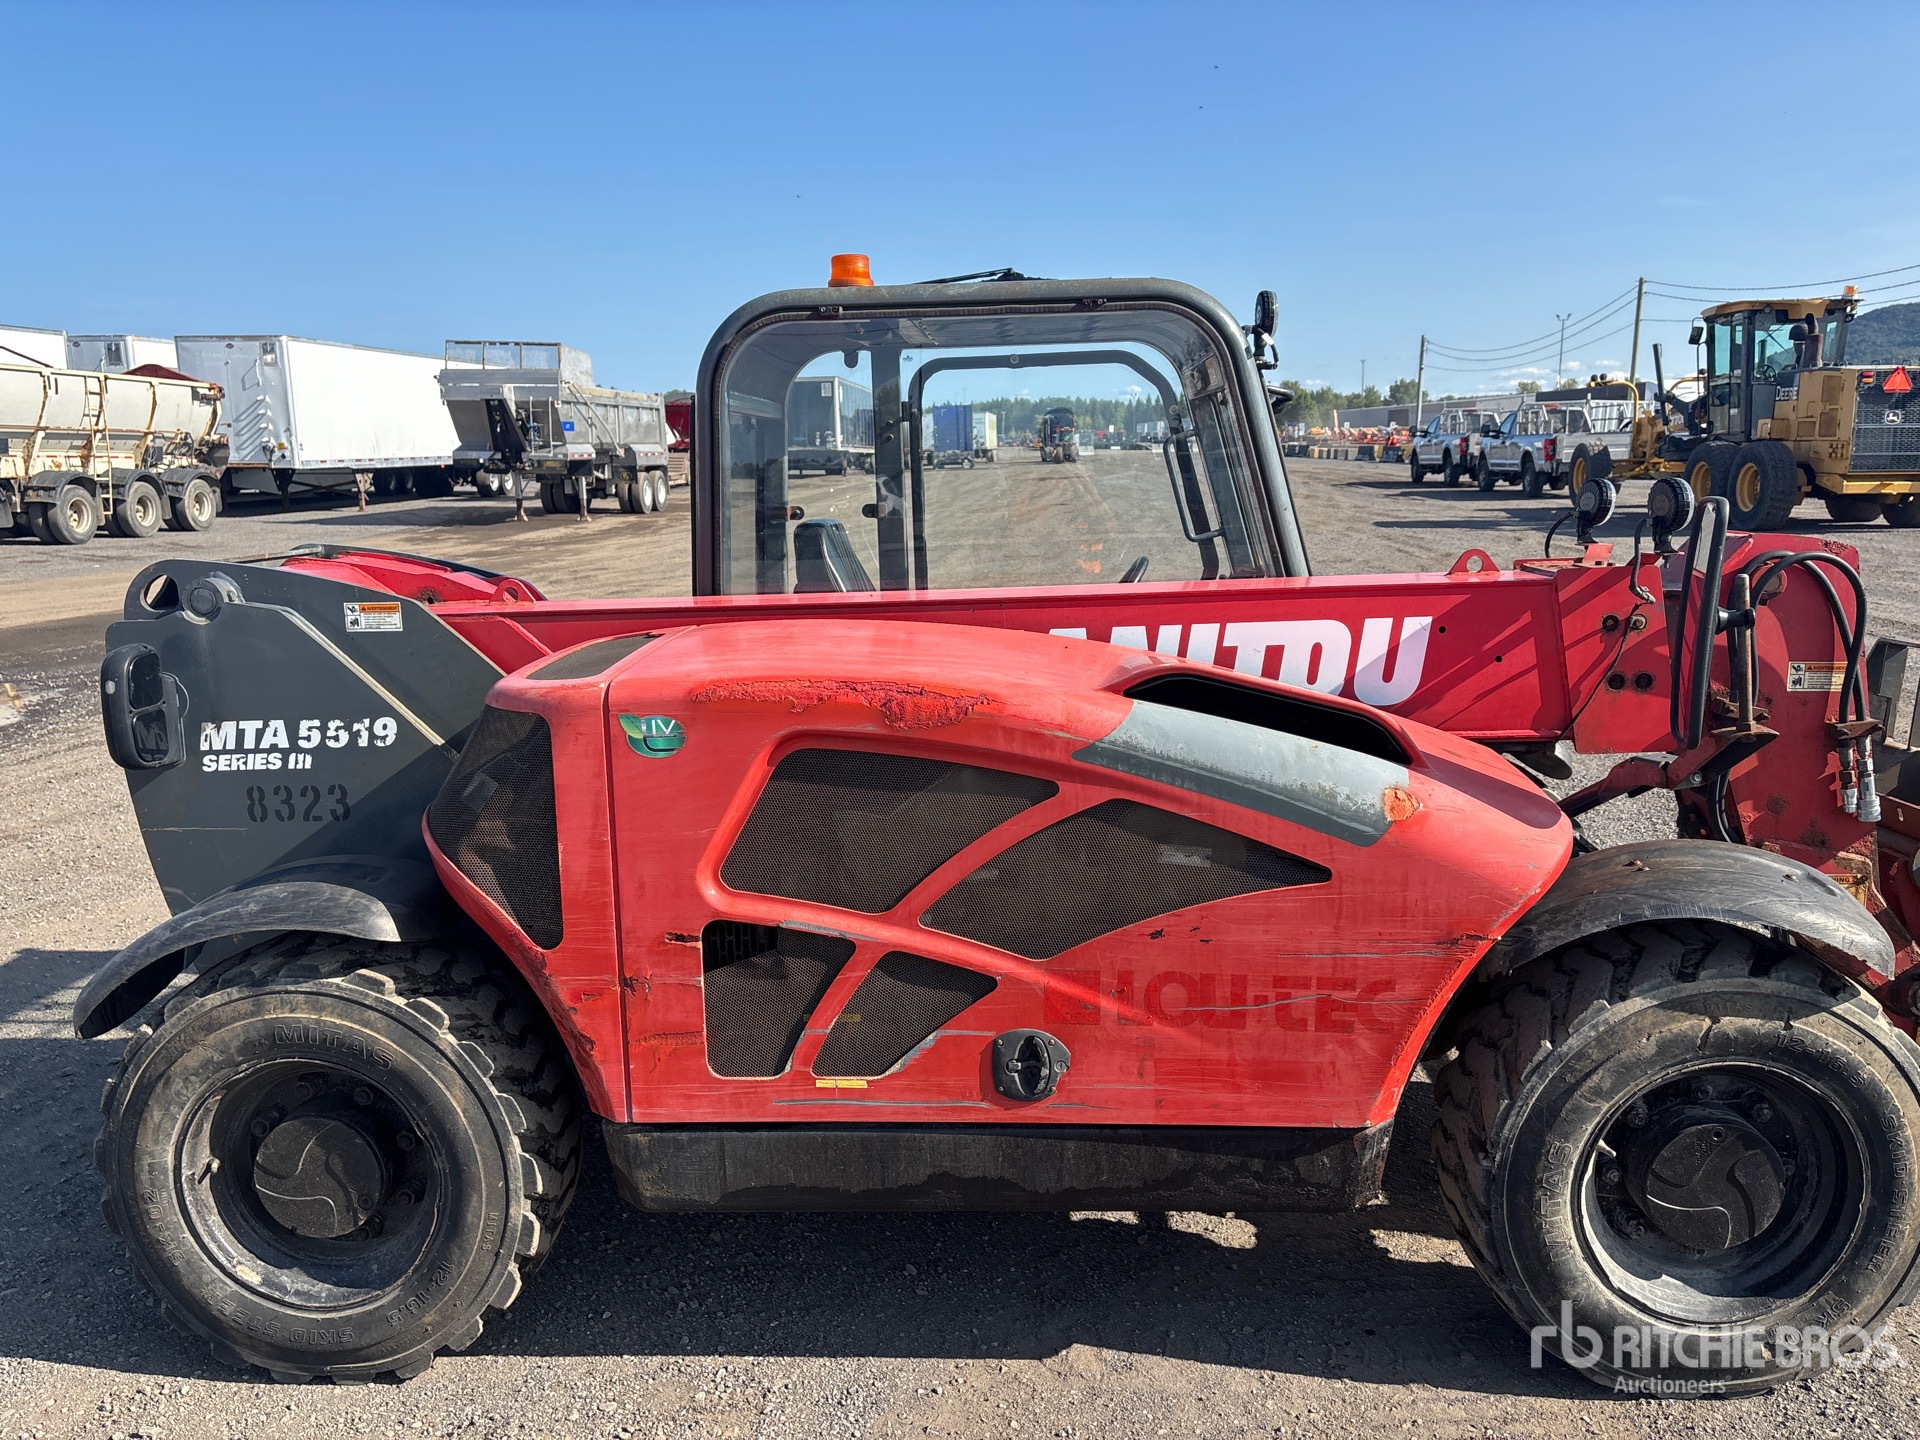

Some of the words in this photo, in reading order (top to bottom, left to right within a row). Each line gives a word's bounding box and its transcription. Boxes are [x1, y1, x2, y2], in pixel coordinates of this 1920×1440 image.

[200, 719, 290, 751] MTA
[202, 752, 283, 772] SERIES
[246, 783, 352, 823] 8323
[273, 1024, 396, 1071] MITAS
[1880, 1113, 1910, 1179] SKID
[1539, 1140, 1573, 1262] MITAS
[386, 1260, 455, 1328] 12-16.5
[289, 1326, 356, 1346] SKID
